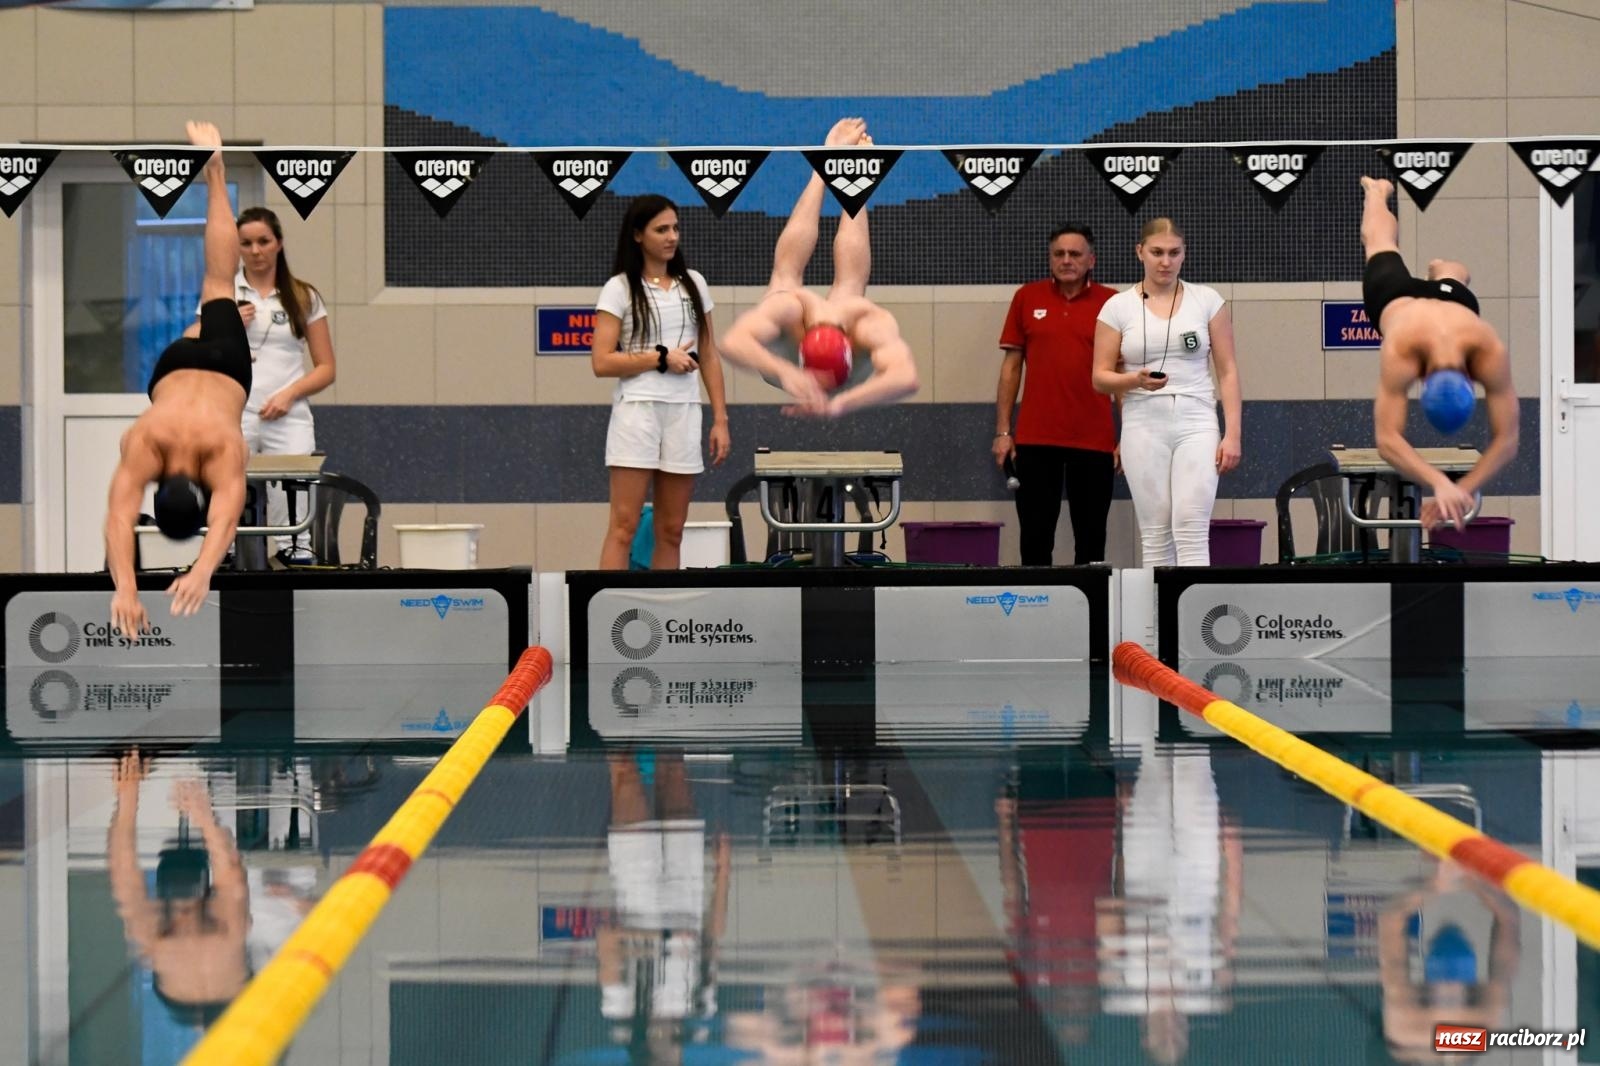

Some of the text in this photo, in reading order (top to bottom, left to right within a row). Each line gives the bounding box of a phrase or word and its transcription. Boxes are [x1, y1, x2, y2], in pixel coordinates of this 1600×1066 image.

[0, 157, 37, 174] ena
[964, 157, 1020, 174] arena
[1104, 156, 1160, 172] arena
[1247, 154, 1303, 171] arena
[1393, 152, 1449, 168] arena
[1531, 149, 1587, 165] arena
[134, 159, 190, 176] arena
[277, 159, 332, 176] arena
[414, 159, 470, 176] arena
[552, 159, 609, 176] arena
[690, 159, 747, 176] arena
[824, 158, 880, 175] arena
[1350, 309, 1370, 323] ZA
[551, 332, 594, 346] BIEG
[1340, 327, 1383, 341] SKAKA
